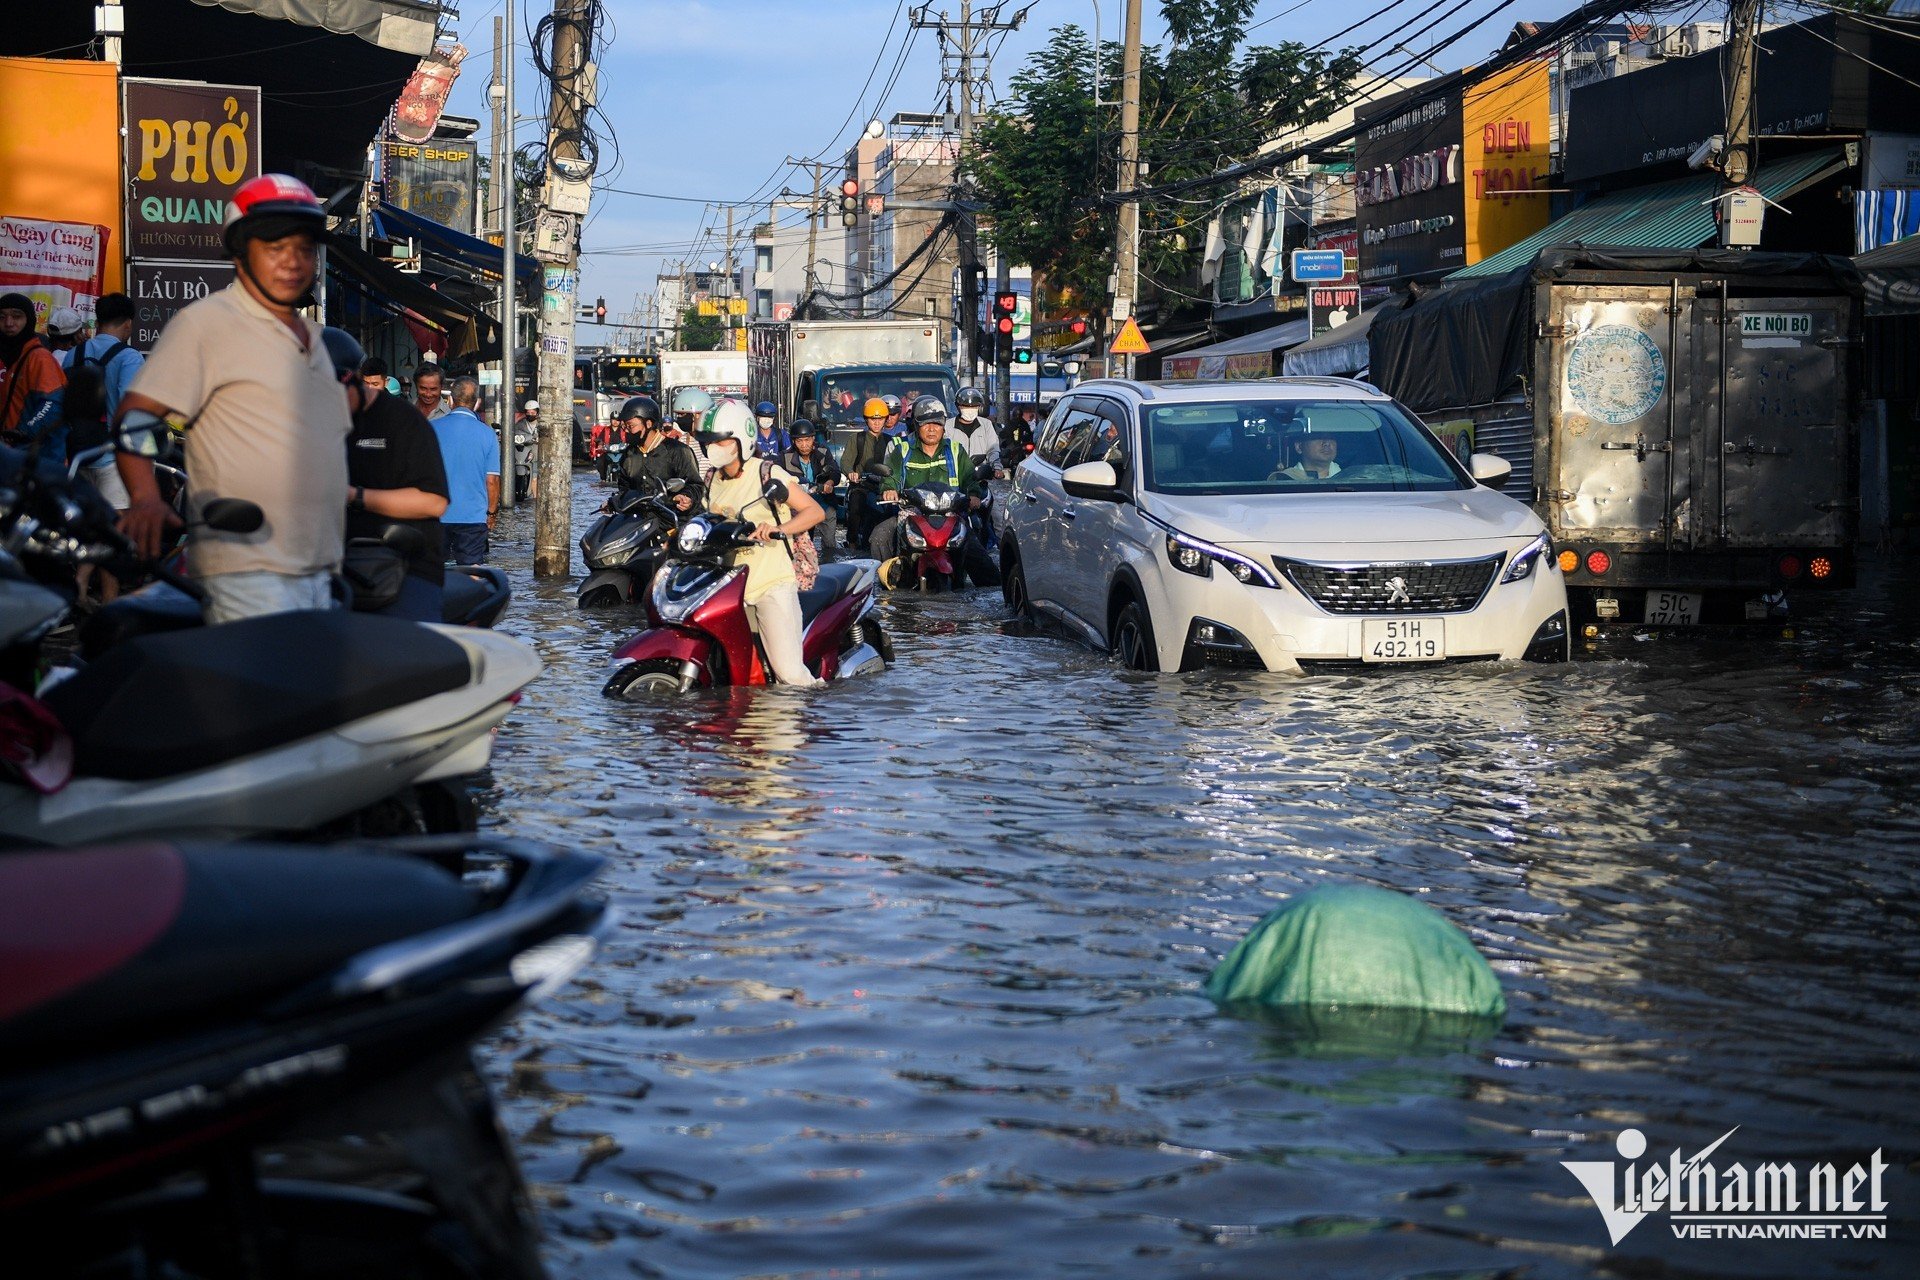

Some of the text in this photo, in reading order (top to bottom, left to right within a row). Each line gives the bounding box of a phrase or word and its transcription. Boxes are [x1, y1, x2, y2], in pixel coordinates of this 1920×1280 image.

[138, 96, 249, 185] PHỞ
[1483, 116, 1530, 158] ĐIỆN
[425, 149, 469, 161] SHOP
[1656, 147, 1666, 160] 189
[1668, 146, 1686, 161] Phạm
[1473, 167, 1539, 206] THOẠI
[141, 196, 224, 224] QUAN
[0, 222, 94, 252] Ngày Cúng
[140, 232, 223, 248] HƯƠNG VỊ HÀ
[64, 254, 94, 267] Kiệm
[138, 271, 210, 300] LẨU BÒ
[1314, 290, 1356, 306] GIA HUY
[139, 305, 162, 321] GÀ
[1744, 314, 1809, 334] XE NỘI BỘ
[139, 329, 161, 342] BIA
[1660, 593, 1690, 612] 51C
[1387, 621, 1421, 638] 51H
[1373, 640, 1435, 658] 492.19
